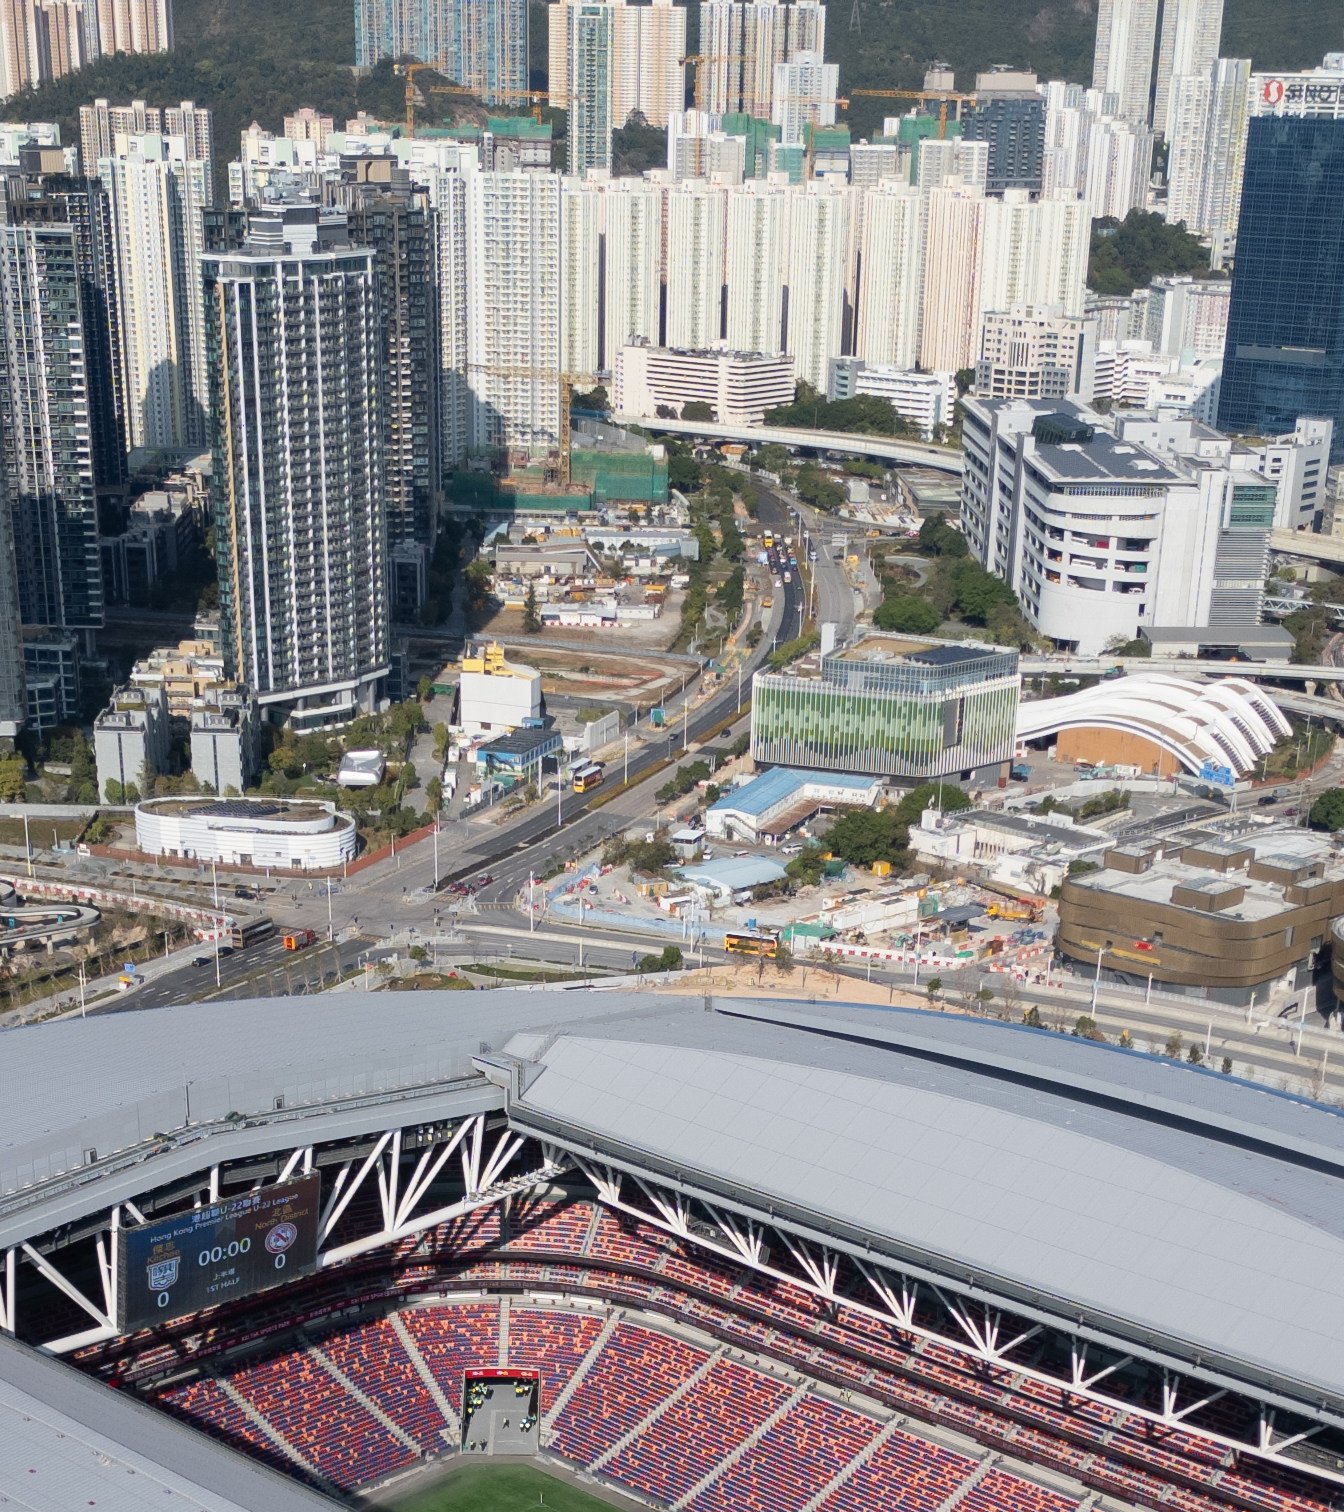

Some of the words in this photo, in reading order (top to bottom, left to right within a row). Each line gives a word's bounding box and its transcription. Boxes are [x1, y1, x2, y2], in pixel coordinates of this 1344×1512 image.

[150, 1233, 172, 1244] Hong
[173, 1226, 194, 1237] Kong
[195, 1216, 223, 1230] Premier
[225, 1208, 252, 1221] League
[254, 1217, 278, 1230] North
[280, 1208, 309, 1222] District
[198, 1237, 251, 1266] 00:00
[274, 1253, 286, 1270] 0
[206, 1282, 220, 1294] 1ST
[221, 1277, 241, 1289] HALF
[157, 1291, 170, 1308] 0
